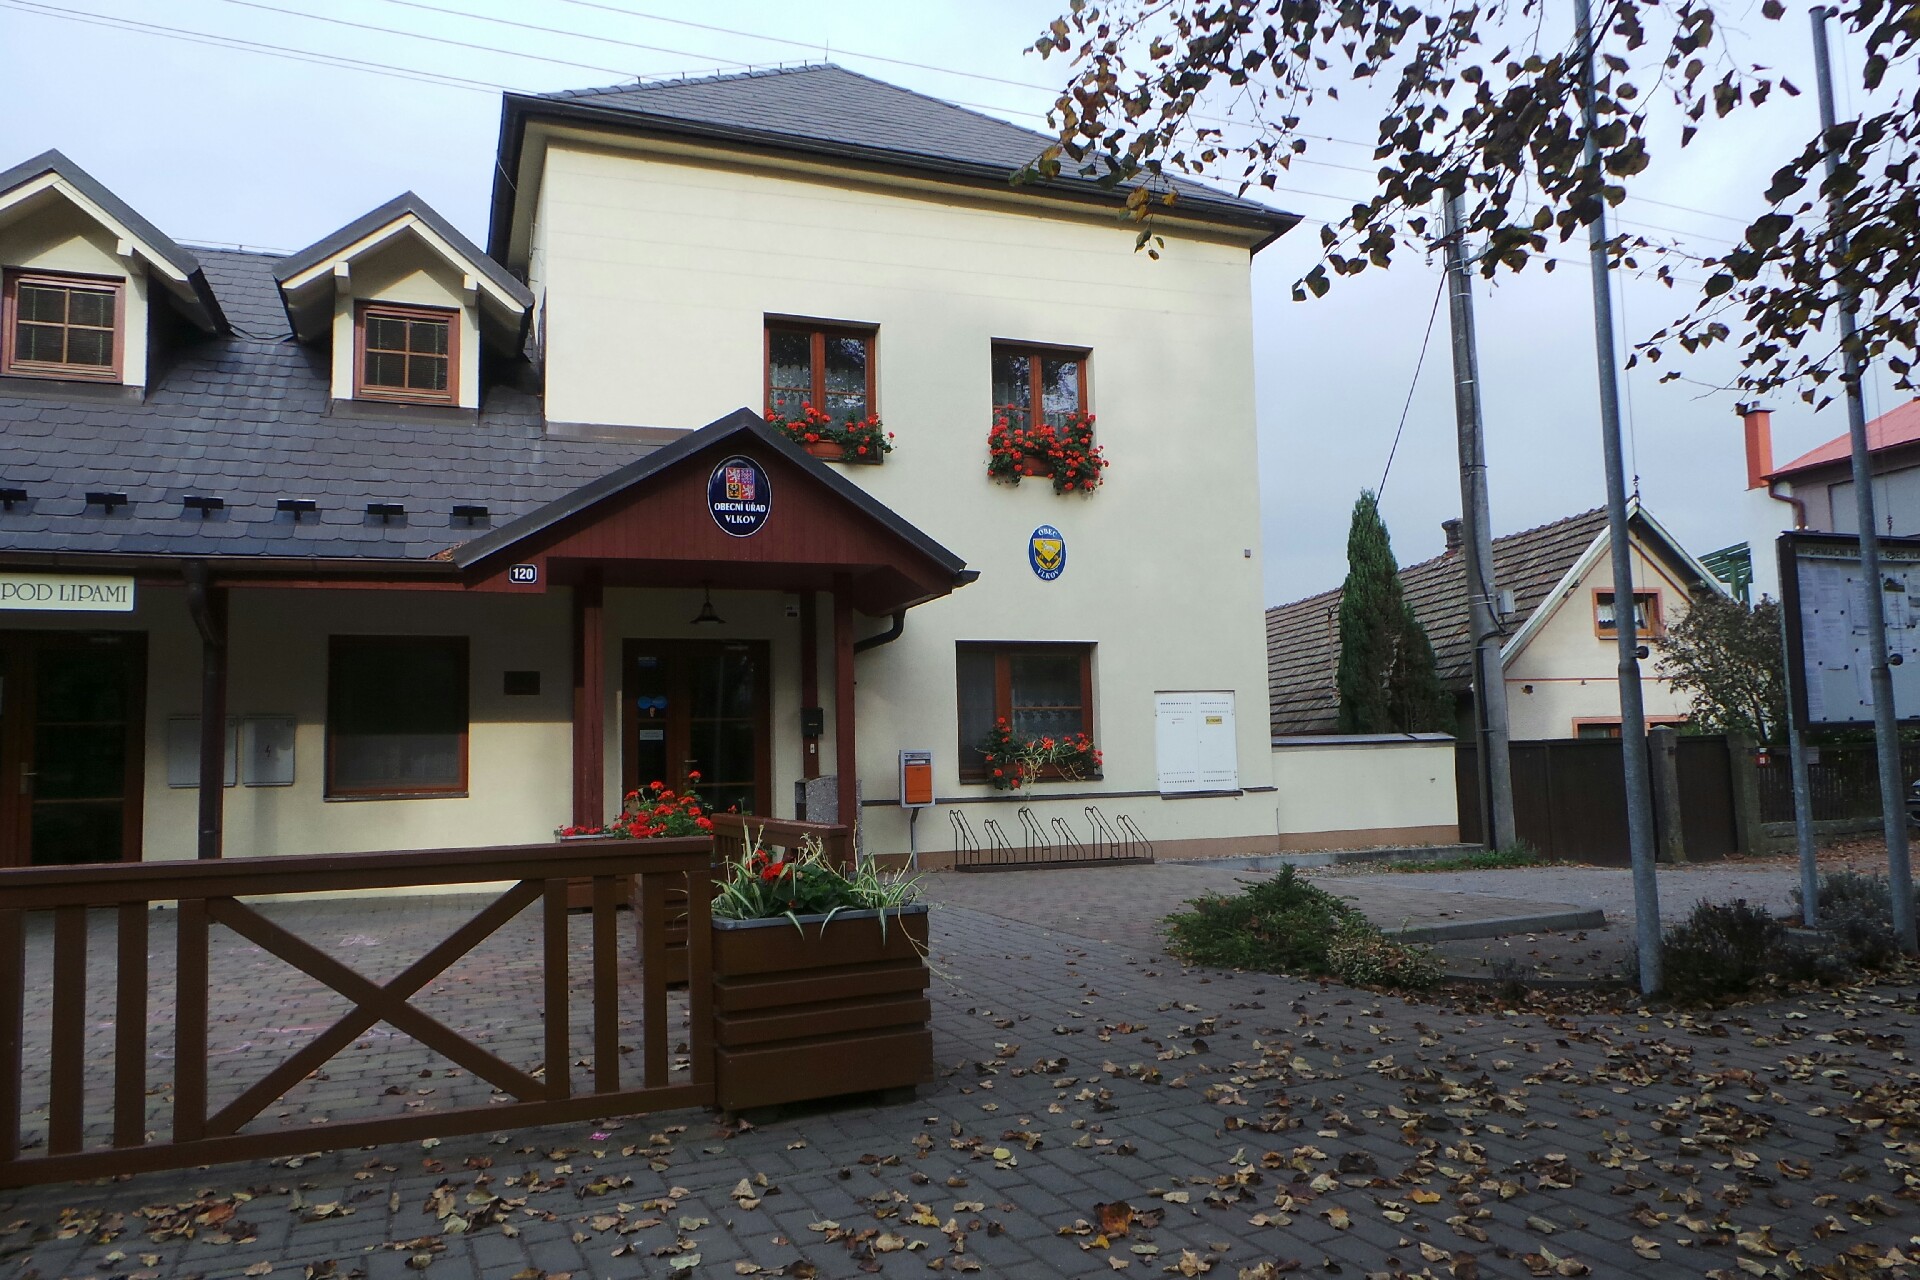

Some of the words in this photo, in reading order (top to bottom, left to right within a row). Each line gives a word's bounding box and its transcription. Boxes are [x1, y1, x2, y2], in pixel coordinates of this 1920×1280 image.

[714, 501, 743, 512] OBECNÍ
[745, 502, 766, 513] ÚŘAD
[724, 514, 756, 524] VLKOV
[1038, 528, 1058, 537] OBEC
[512, 567, 534, 580] 120
[1037, 567, 1059, 579] VLKOV
[1, 582, 53, 601] POD
[58, 584, 128, 603] LIPAMI
